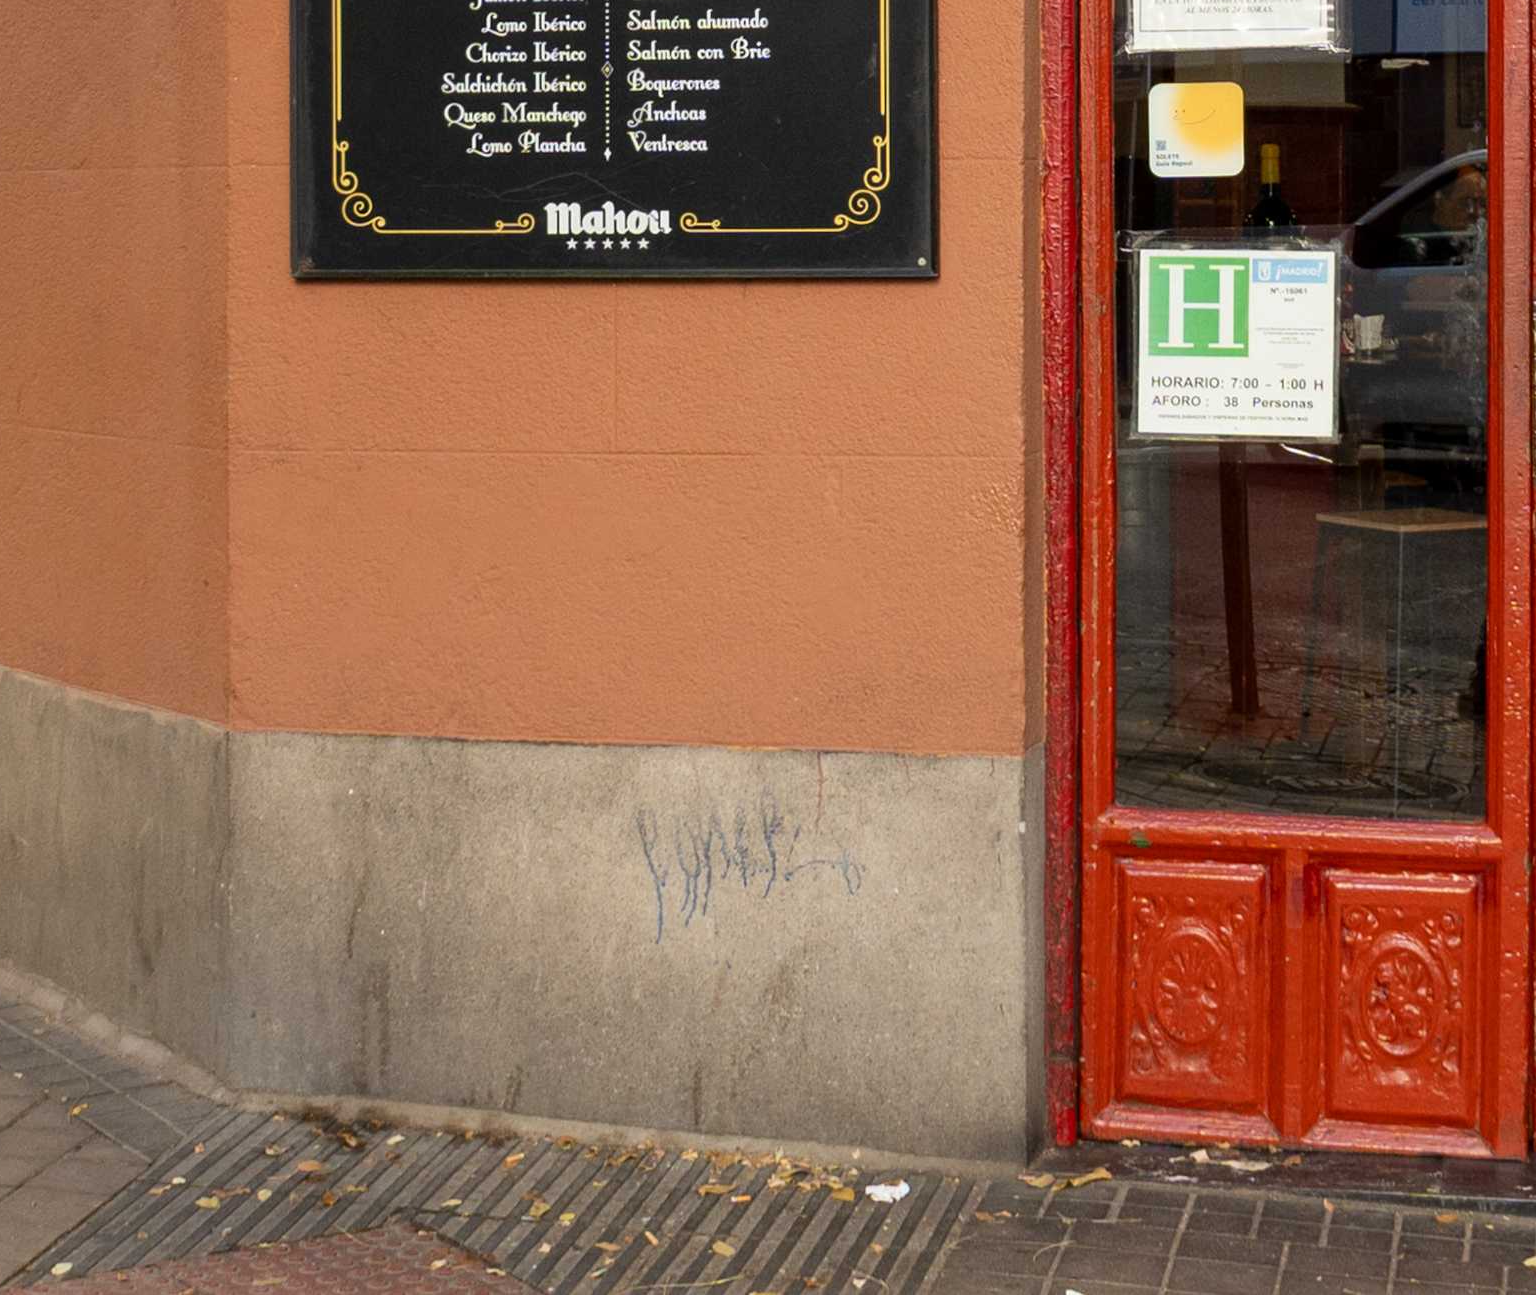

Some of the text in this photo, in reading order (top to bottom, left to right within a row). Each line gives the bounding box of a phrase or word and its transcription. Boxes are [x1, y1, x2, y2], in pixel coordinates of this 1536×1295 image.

[466, 42, 586, 62] Chorizo Ibérico
[467, 130, 586, 157] Lomo Plancha
[544, 201, 672, 235] Mahou
[1157, 263, 1246, 348] H
[1150, 376, 1224, 390] HORARIO:
[1231, 377, 1259, 390] 7:00
[1280, 378, 1307, 390] 1:00
[1314, 379, 1324, 391] H
[1224, 395, 1239, 408] 38
[1252, 396, 1315, 410] Personas
